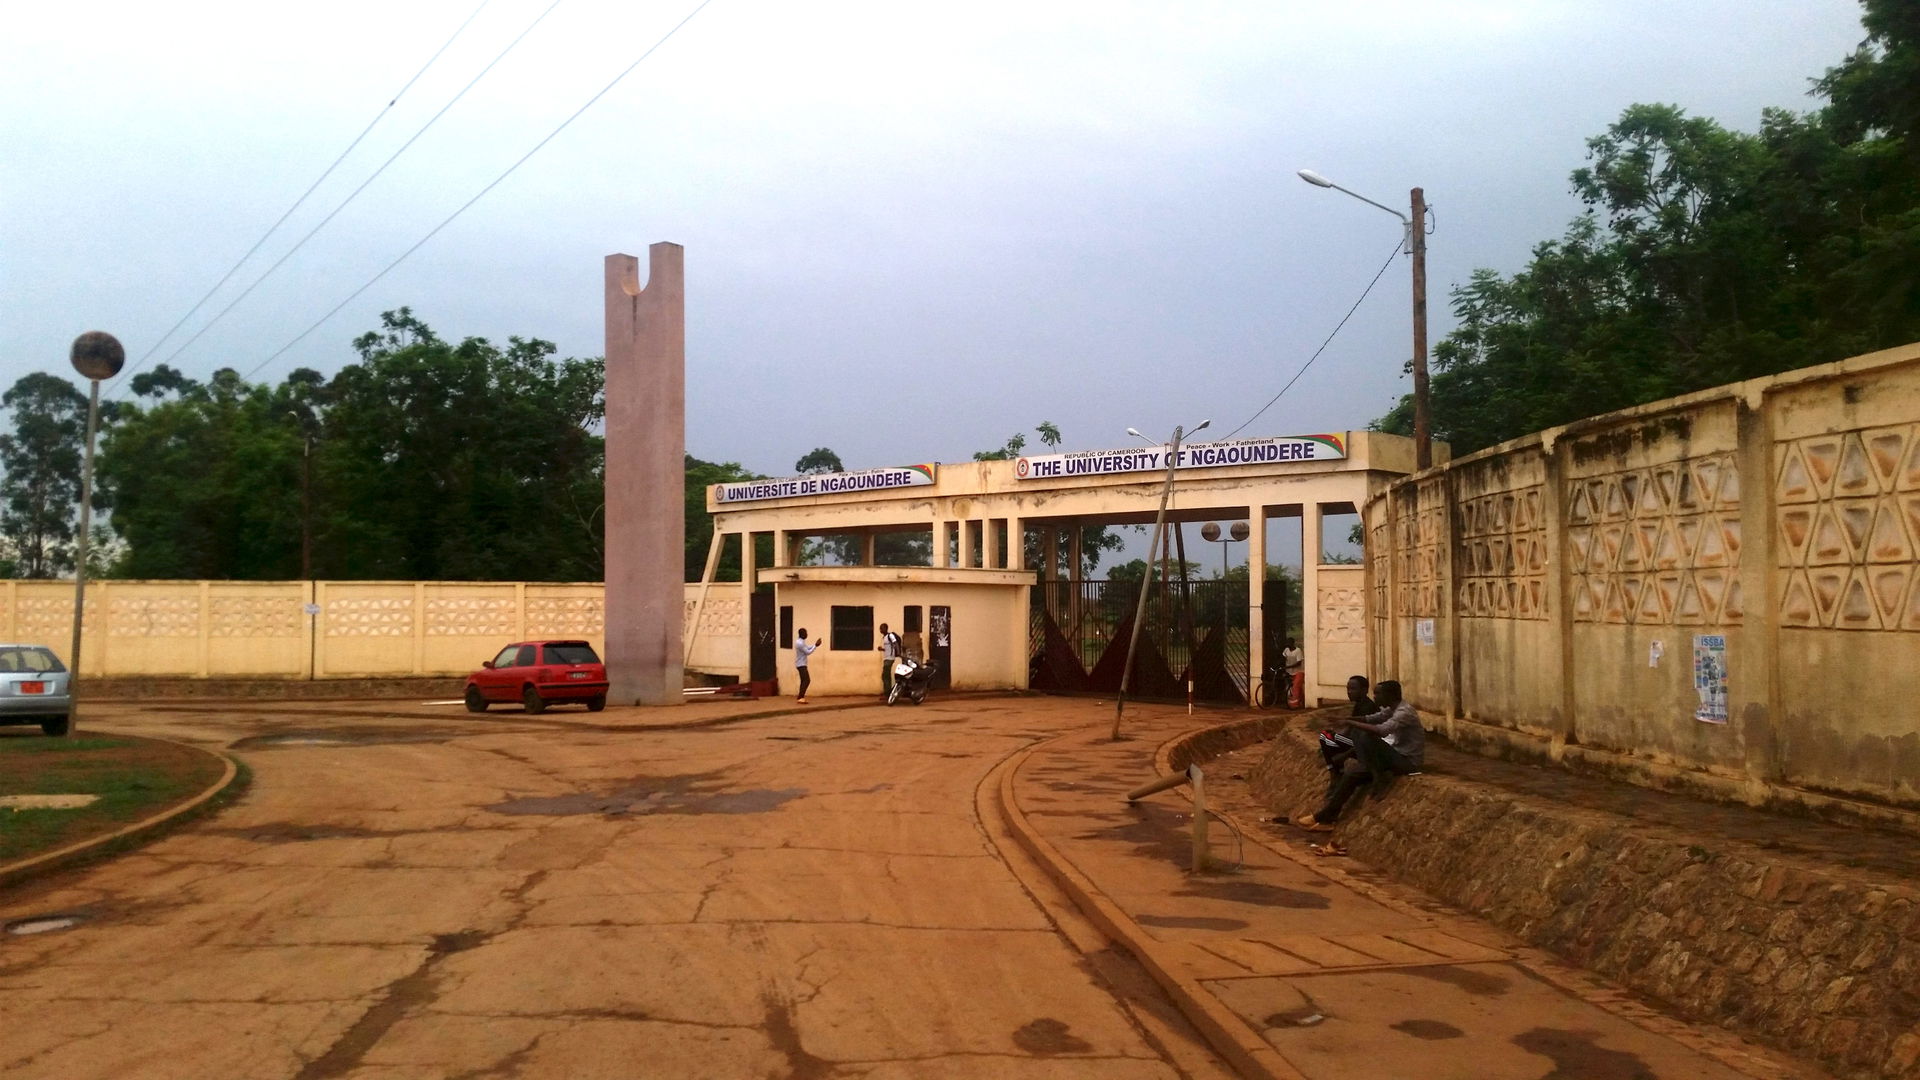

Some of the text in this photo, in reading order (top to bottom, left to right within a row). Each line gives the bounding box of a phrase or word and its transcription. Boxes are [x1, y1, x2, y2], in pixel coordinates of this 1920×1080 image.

[1236, 439, 1274, 447] Fatherland
[1033, 461, 1061, 476] THE
[1066, 453, 1159, 474] UNIVERSITY
[1191, 442, 1315, 466] NGAOUNDERE
[1064, 451, 1096, 459] REPUBLIC
[1107, 448, 1146, 456] CAMEROON
[728, 471, 911, 500] UNIVERSITE DE NGAOUNDERE
[1701, 638, 1725, 647] ISSBA
